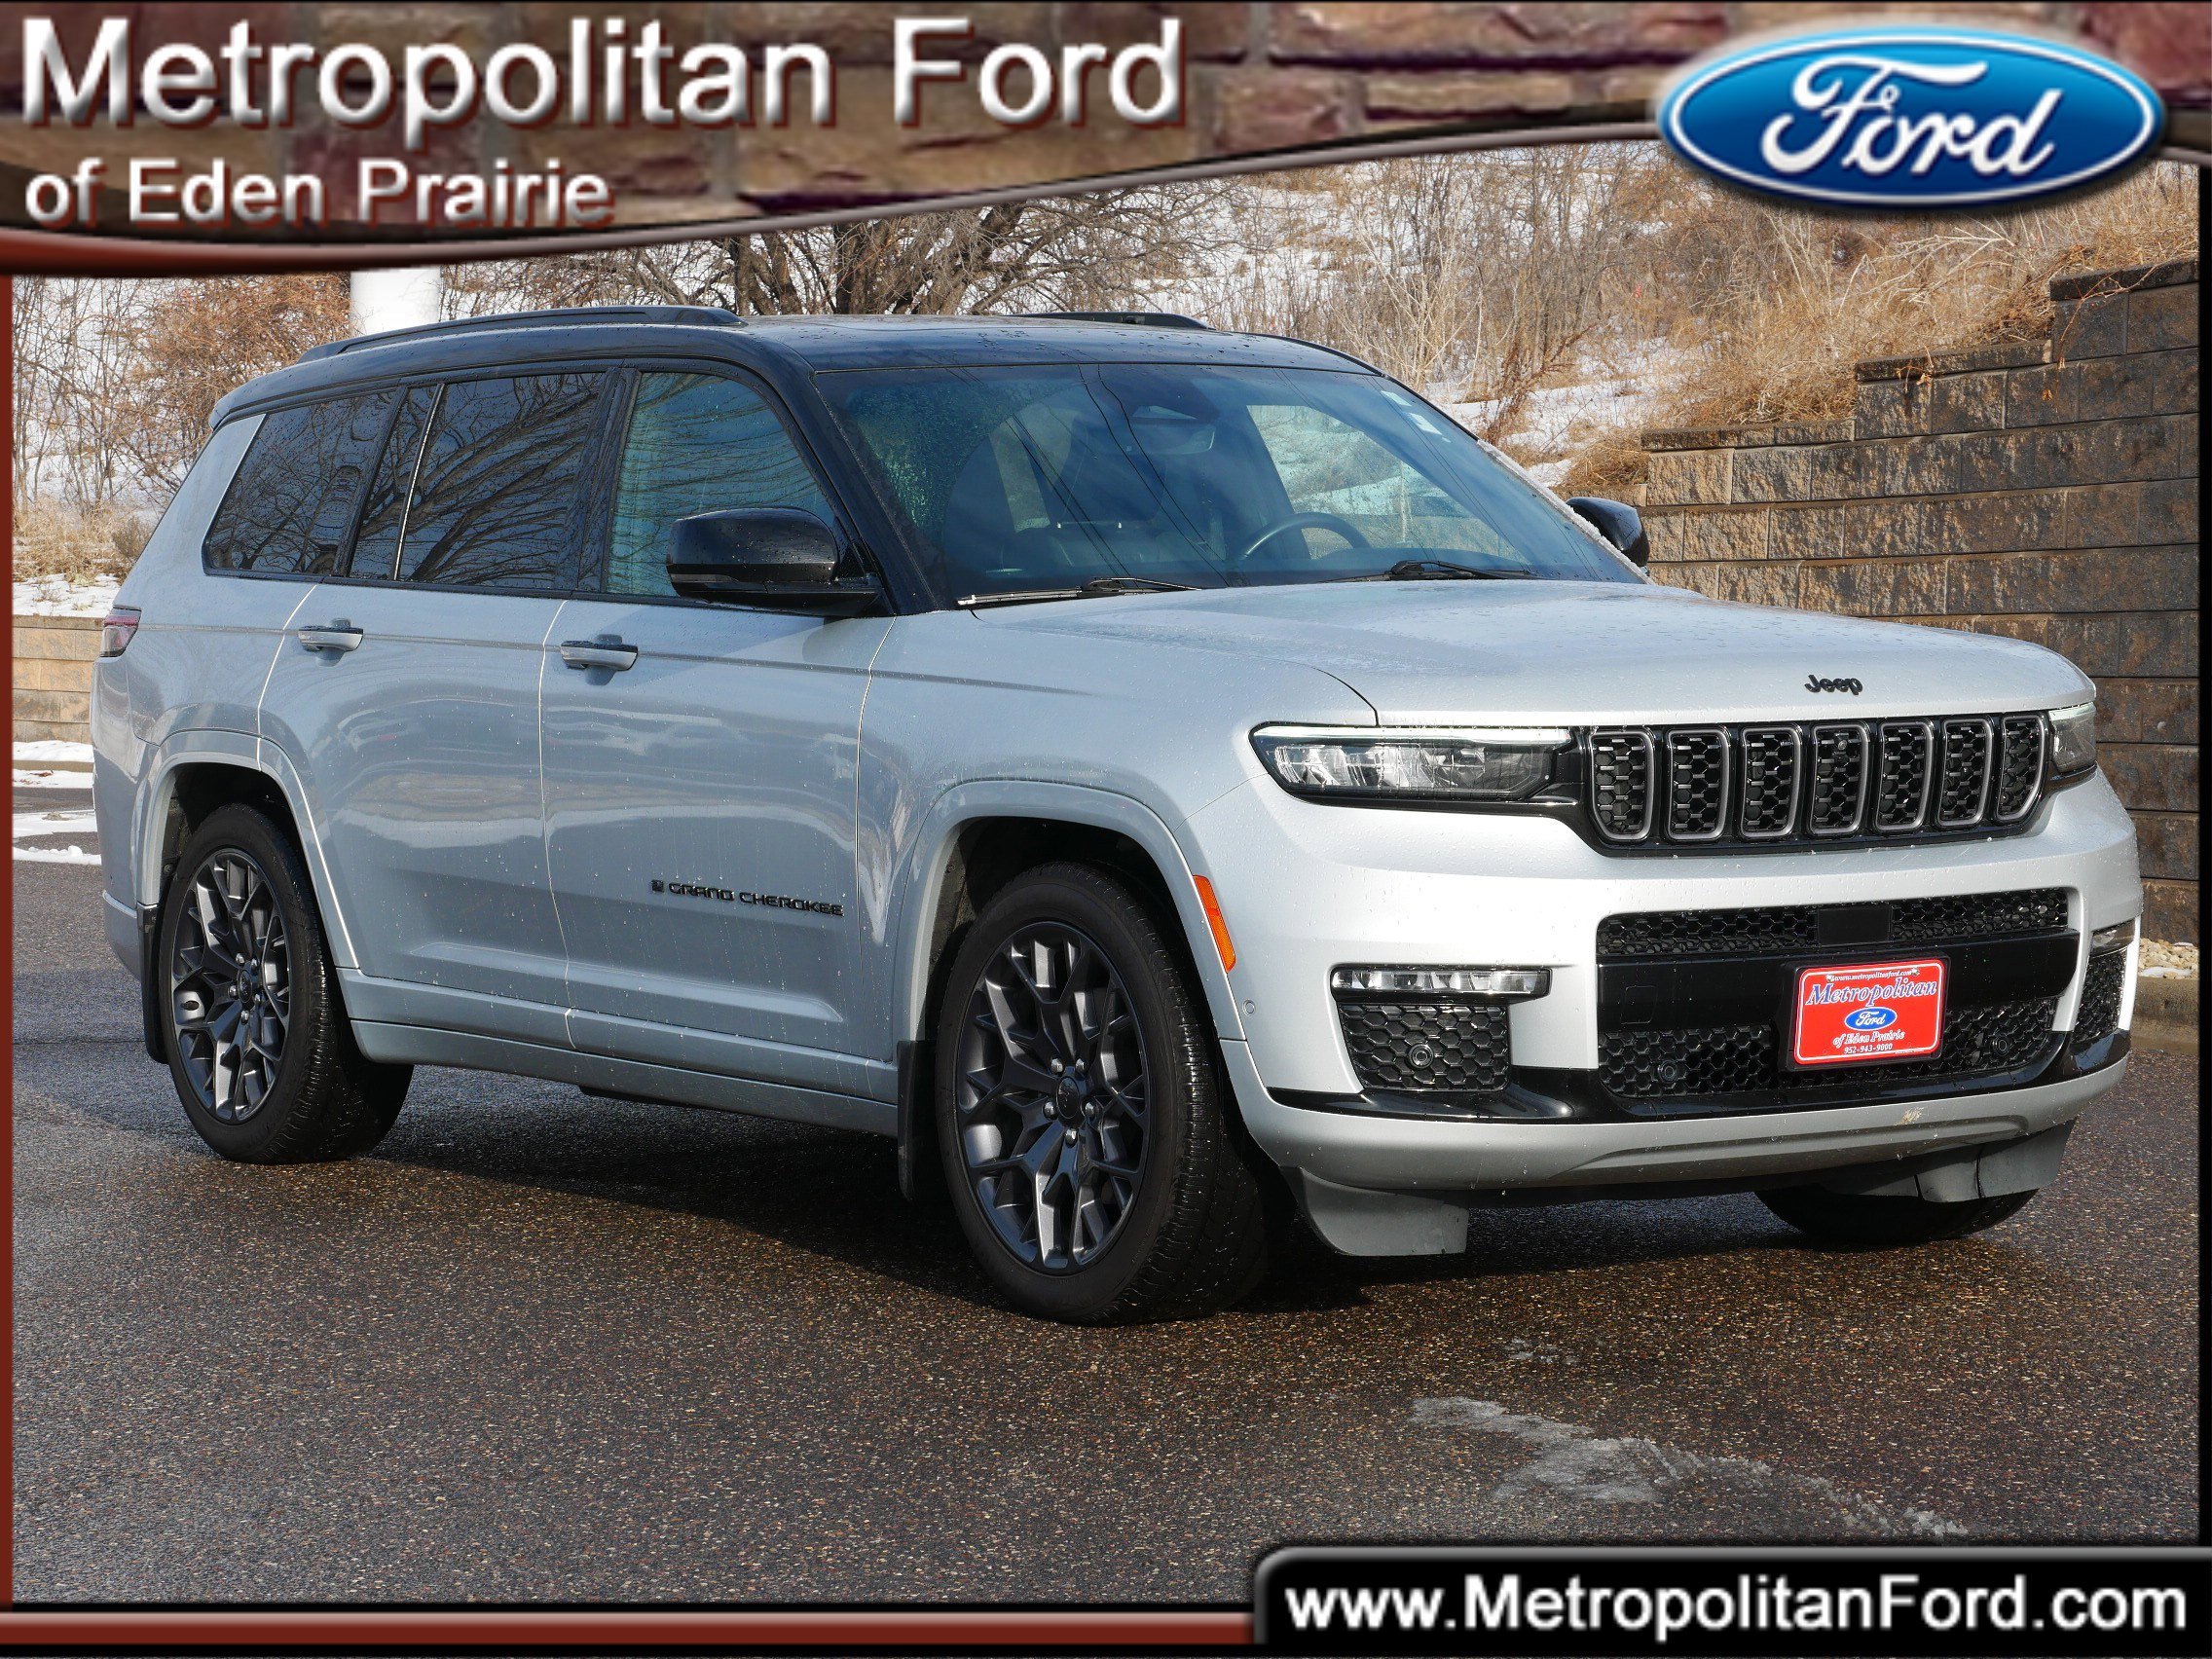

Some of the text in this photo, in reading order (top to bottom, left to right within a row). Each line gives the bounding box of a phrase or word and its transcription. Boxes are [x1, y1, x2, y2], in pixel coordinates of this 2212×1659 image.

[1804, 674, 1863, 696] Jeep
[669, 882, 845, 917] GRAND CHEROKEE
[1805, 977, 1937, 1007] Metropolitan
[1856, 1011, 1886, 1026] Ford
[1832, 1028, 1905, 1049] of Eden Prairie
[1844, 1043, 1894, 1054] 952-943-9000
